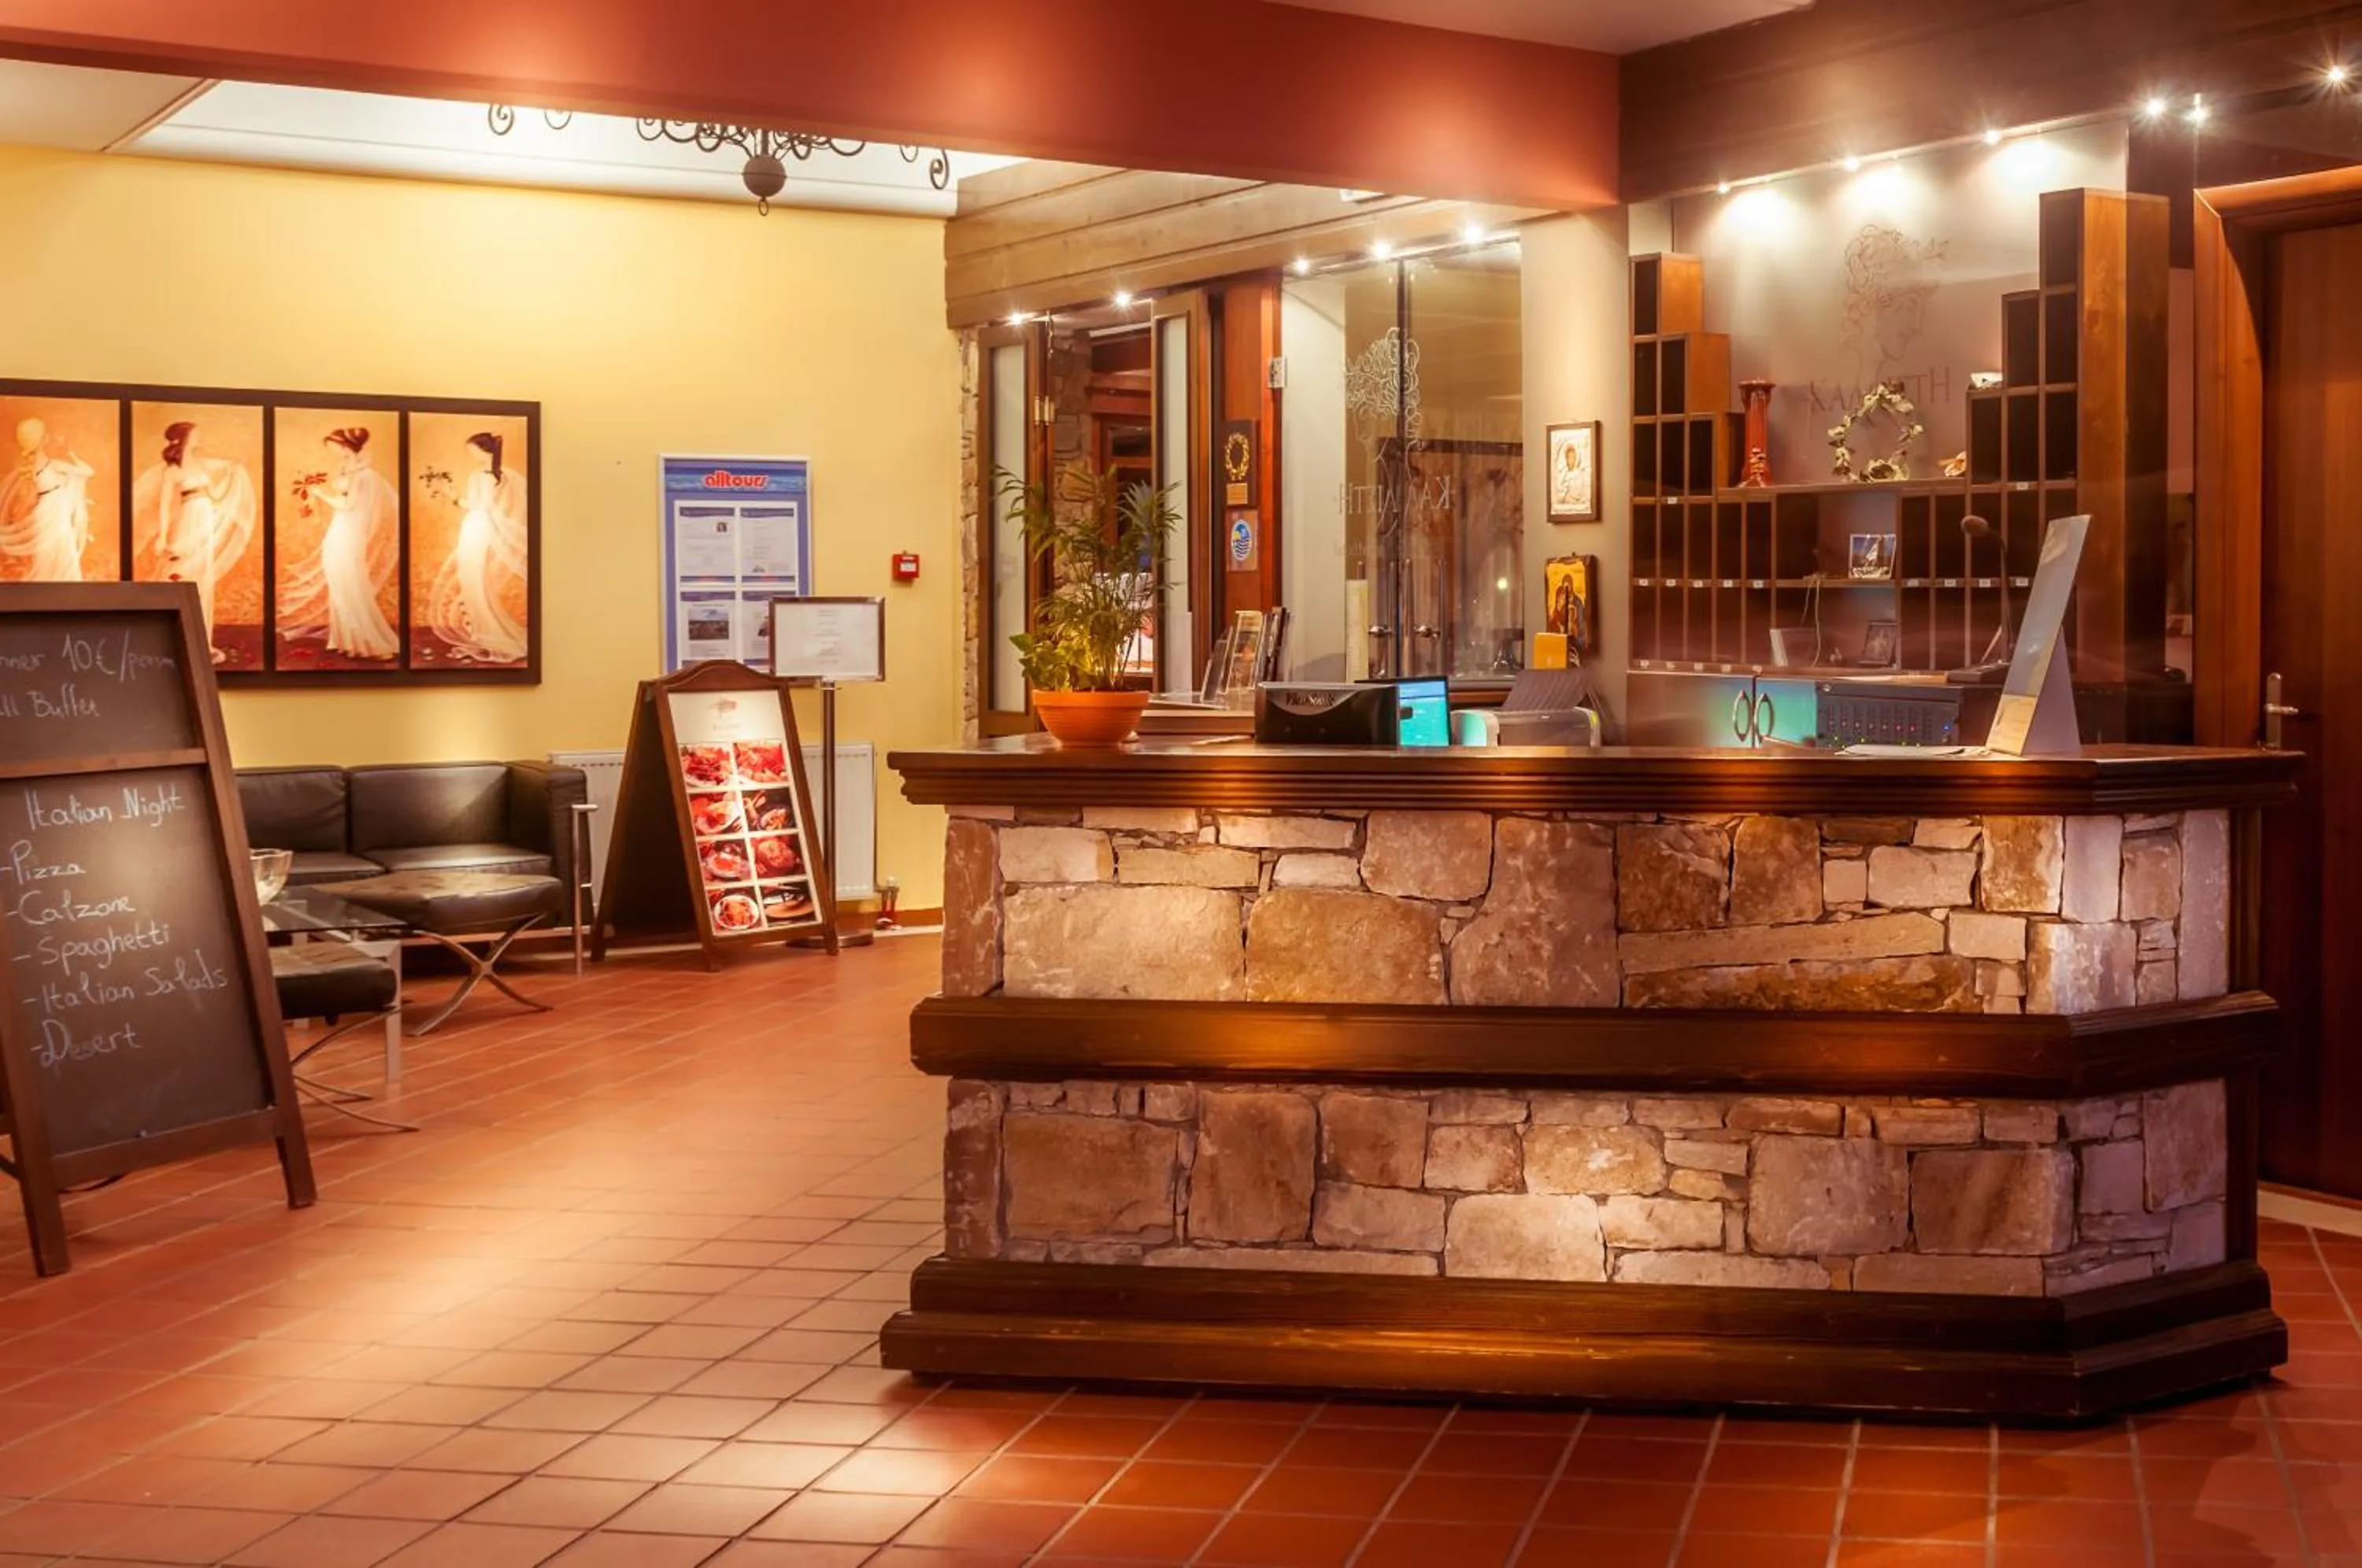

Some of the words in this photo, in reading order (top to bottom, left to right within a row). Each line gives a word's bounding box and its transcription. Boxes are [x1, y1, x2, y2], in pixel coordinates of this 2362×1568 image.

[705, 469, 768, 488] alltours
[24, 787, 113, 830] Italian
[120, 784, 184, 827] Night
